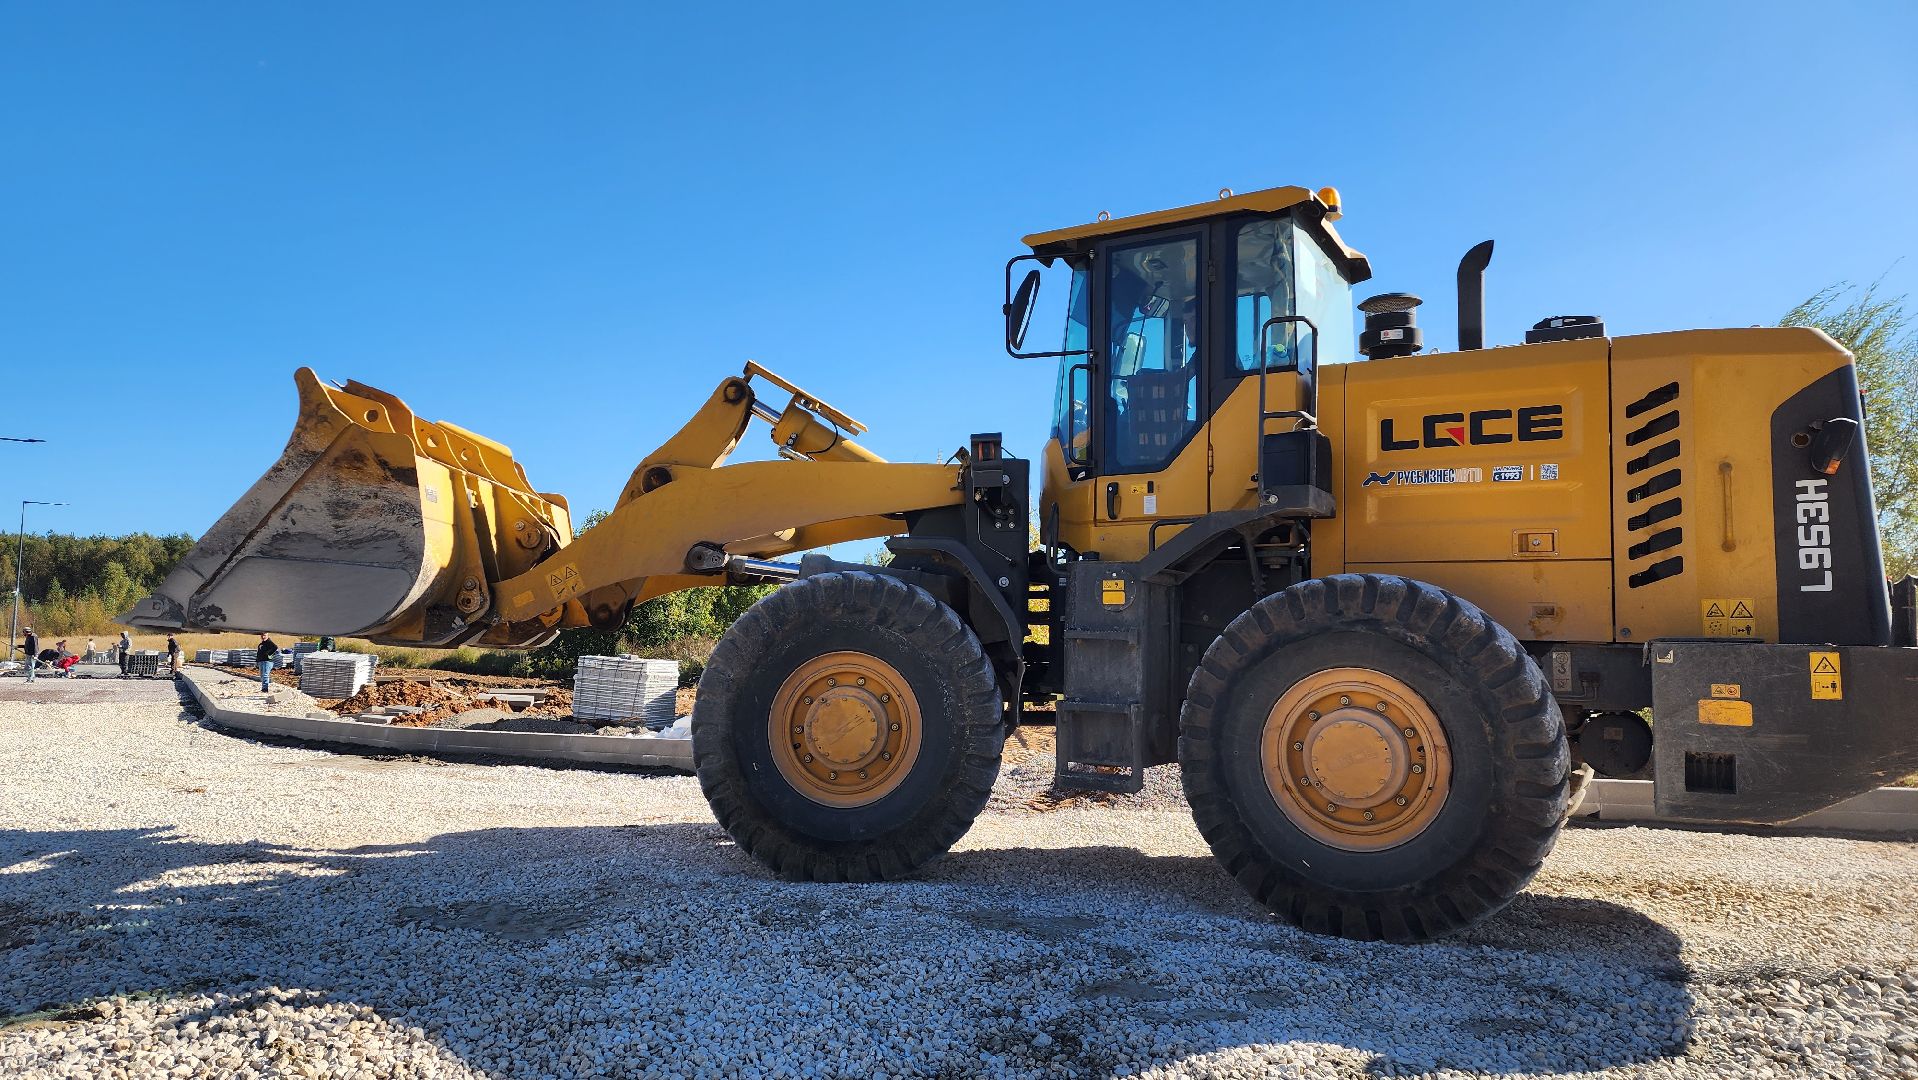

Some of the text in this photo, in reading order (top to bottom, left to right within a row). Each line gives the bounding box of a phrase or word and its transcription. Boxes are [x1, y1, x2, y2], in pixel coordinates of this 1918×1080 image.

[1381, 405, 1563, 451] LGCE
[1501, 472, 1520, 480] 1993
[1795, 478, 1833, 592] L953H
